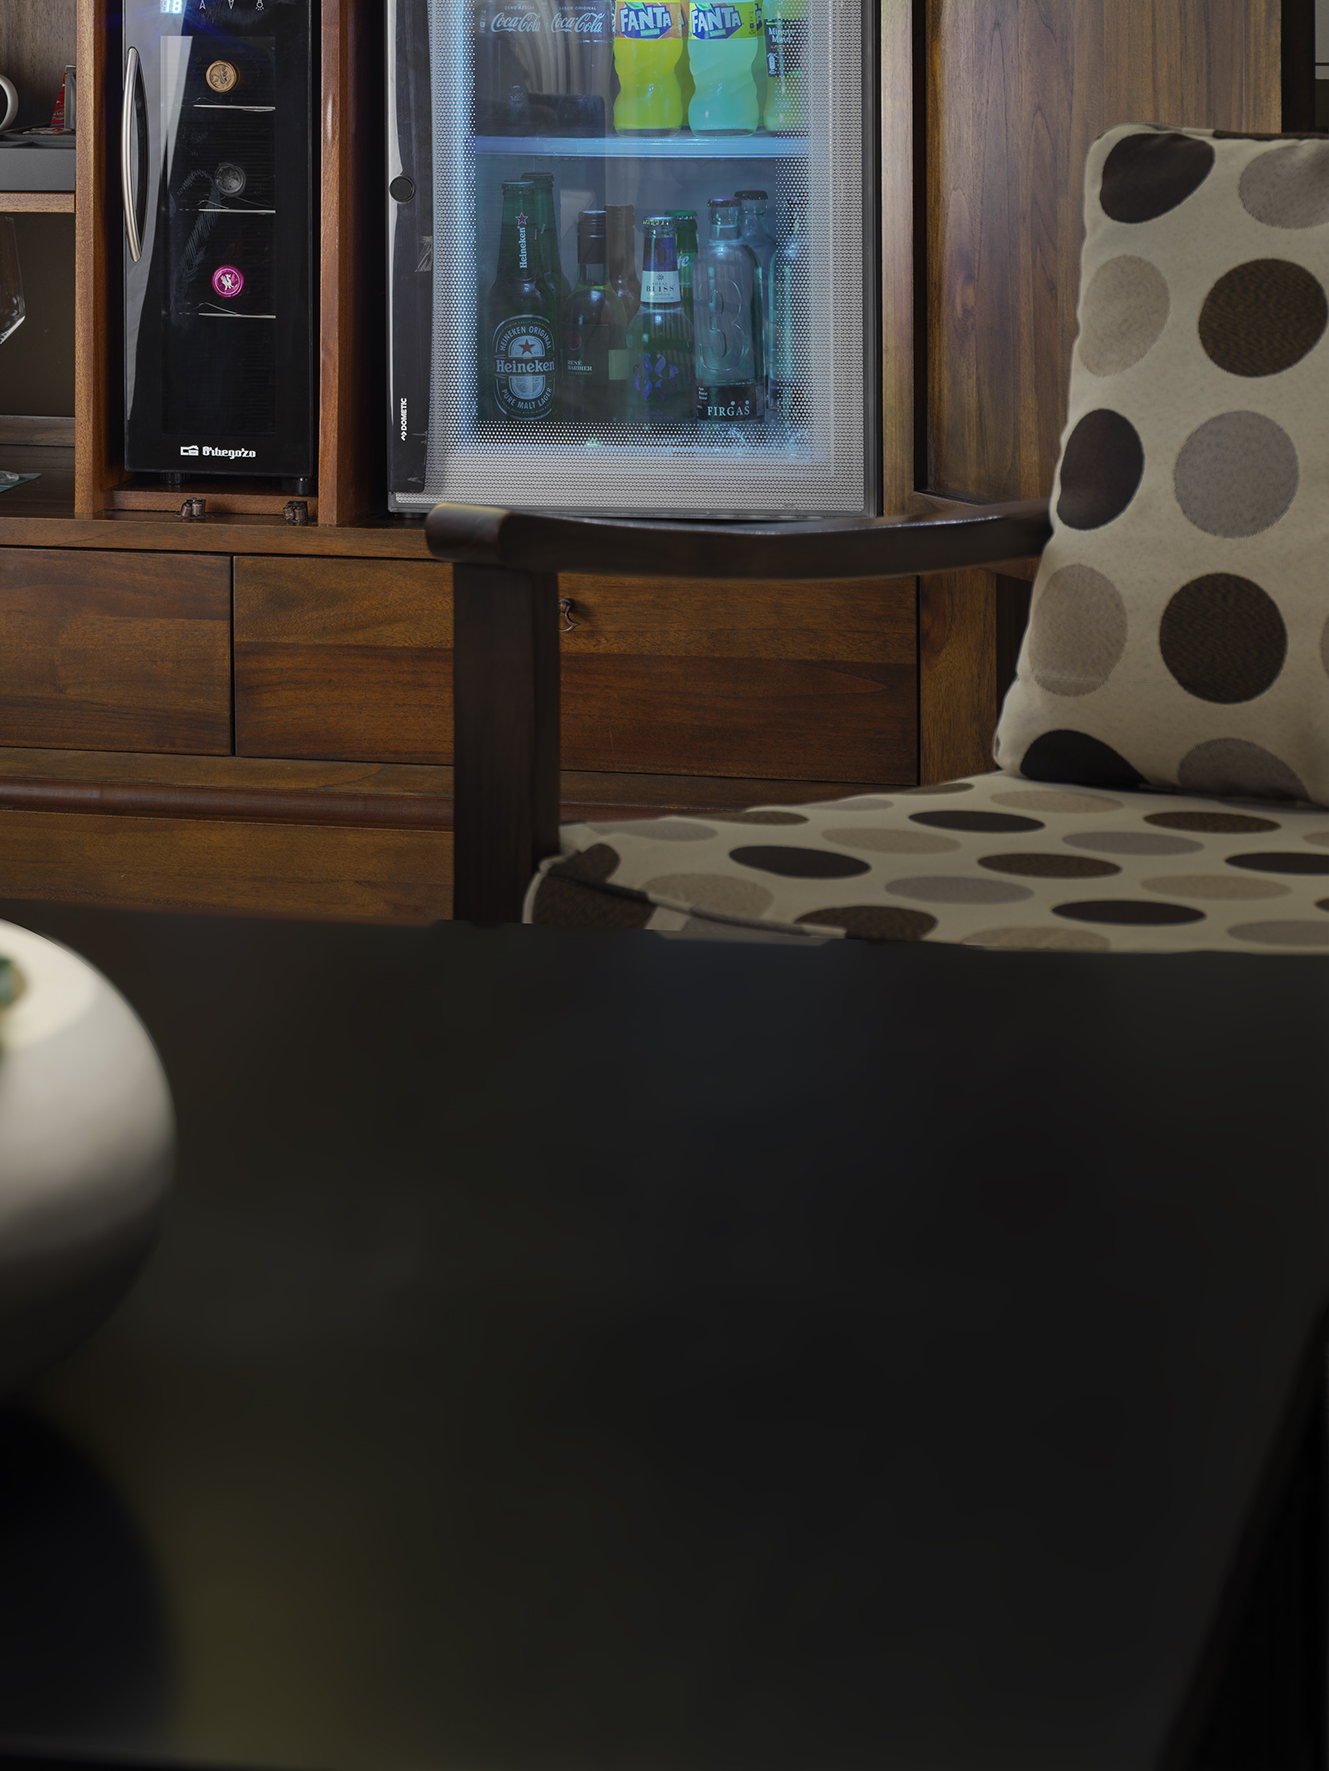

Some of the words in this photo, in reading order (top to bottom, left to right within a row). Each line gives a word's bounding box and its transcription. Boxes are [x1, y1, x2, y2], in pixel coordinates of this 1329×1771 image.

[490, 12, 542, 33] Coca-Cola
[550, 12, 605, 33] Coca-Cola
[620, 6, 672, 33] FANTA
[691, 6, 743, 34] FANTA
[519, 226, 528, 269] Heineken
[500, 326, 526, 352] HEINEKEN
[529, 325, 552, 350] ORIGINAL
[496, 359, 555, 374] Heineken
[502, 388, 516, 407] PURE
[517, 401, 536, 410] MALT
[537, 387, 553, 407] LAGER
[707, 405, 750, 417] FIRGAS
[400, 397, 408, 431] DOMETIC
